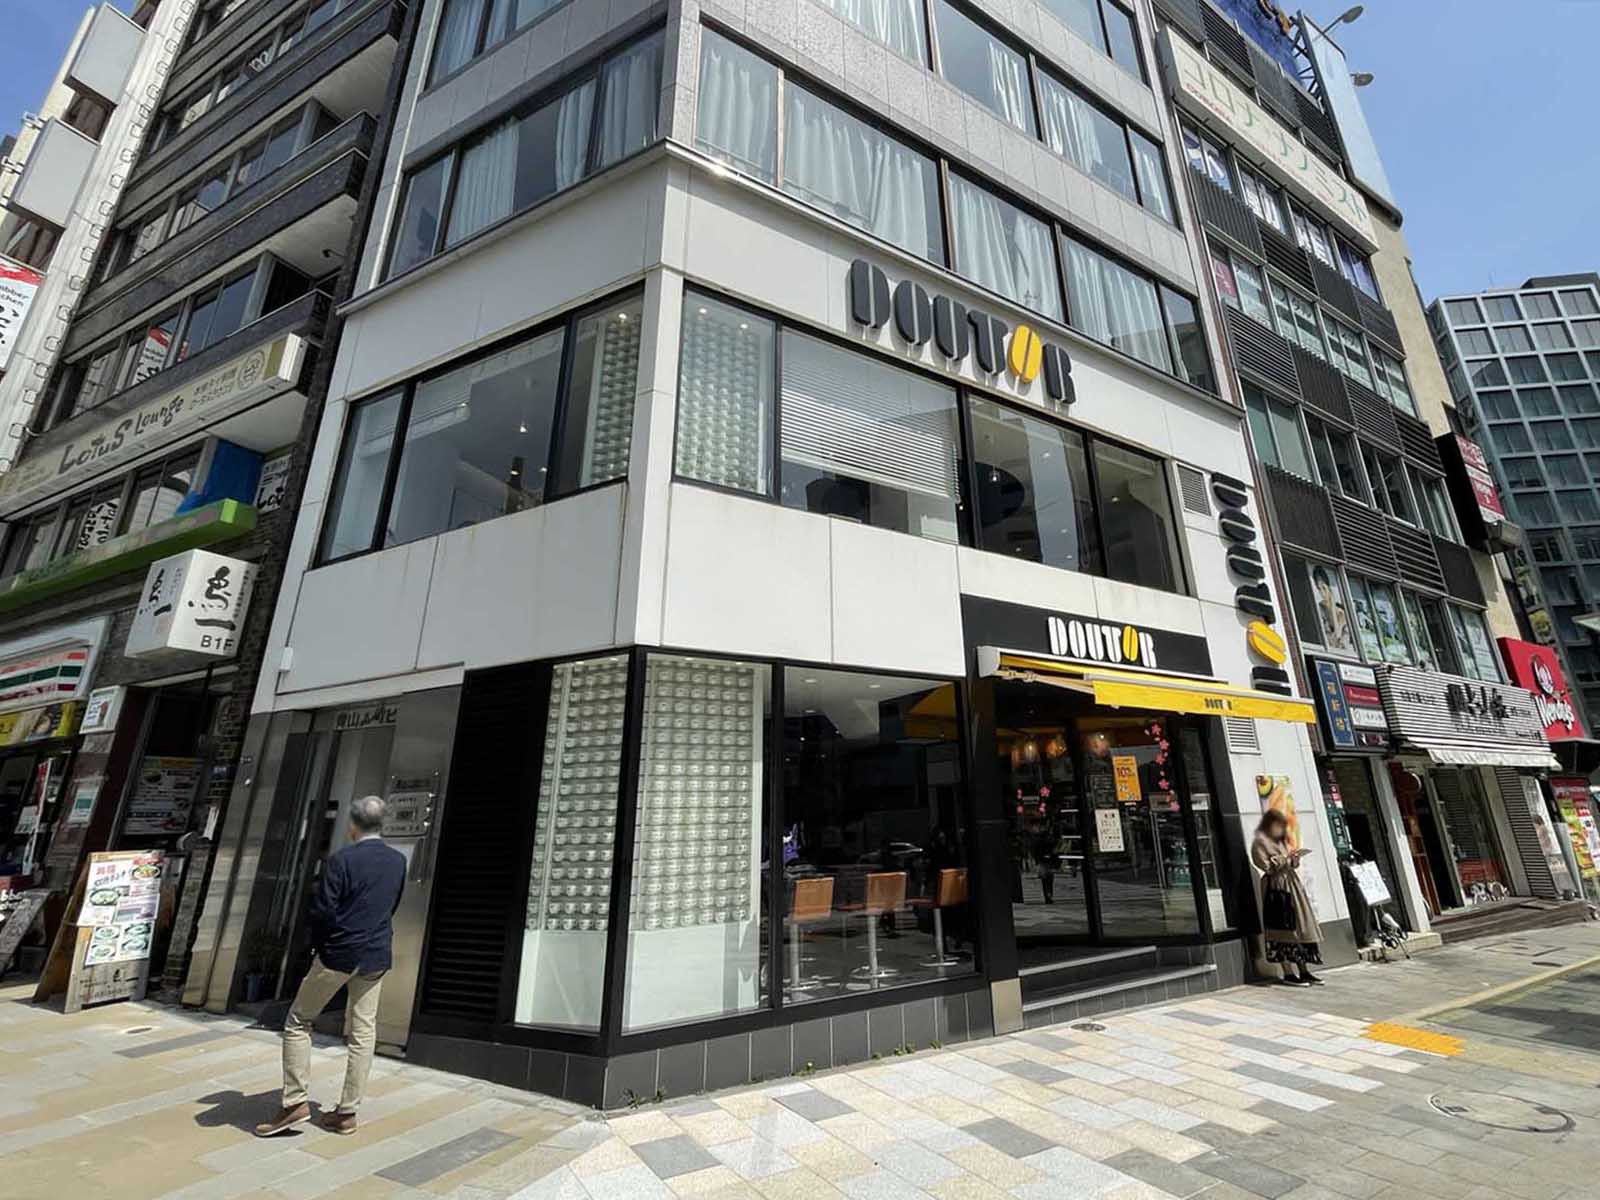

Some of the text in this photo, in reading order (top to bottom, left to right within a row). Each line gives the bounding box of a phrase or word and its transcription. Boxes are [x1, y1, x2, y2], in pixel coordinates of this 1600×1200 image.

[850, 258, 1076, 405] DOUTOR
[1211, 471, 1292, 697] DOUTOR
[200, 634, 234, 651] B1F
[1047, 616, 1157, 669] DOUTOR
